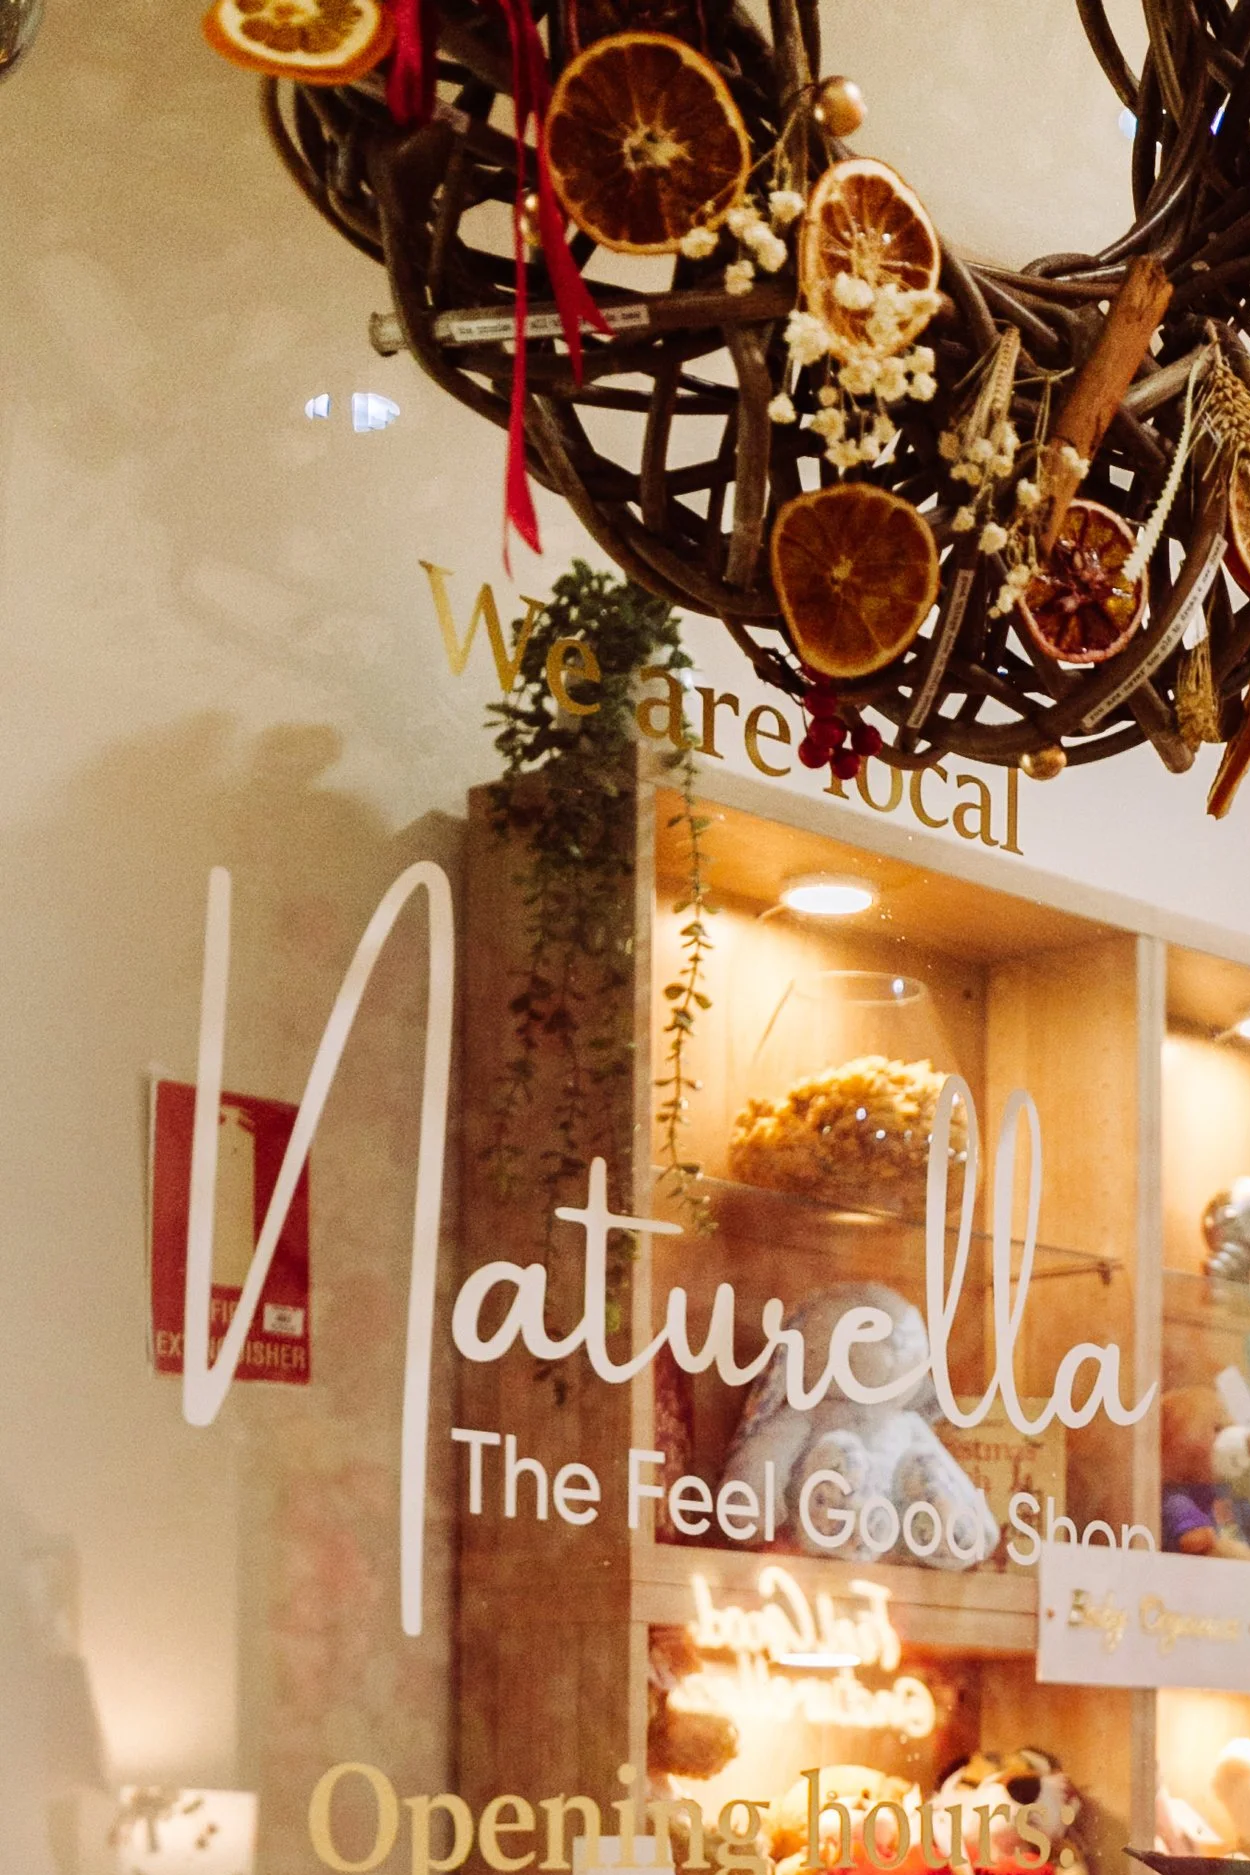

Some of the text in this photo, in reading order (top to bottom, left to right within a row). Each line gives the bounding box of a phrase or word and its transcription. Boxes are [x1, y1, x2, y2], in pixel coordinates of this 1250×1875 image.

[418, 559, 1024, 856] We are ocal
[183, 860, 1159, 1638] Naturella
[450, 1427, 601, 1526] The
[627, 1447, 776, 1542] Feel
[799, 1469, 985, 1561] Good
[800, 1767, 1076, 1870] hours:
